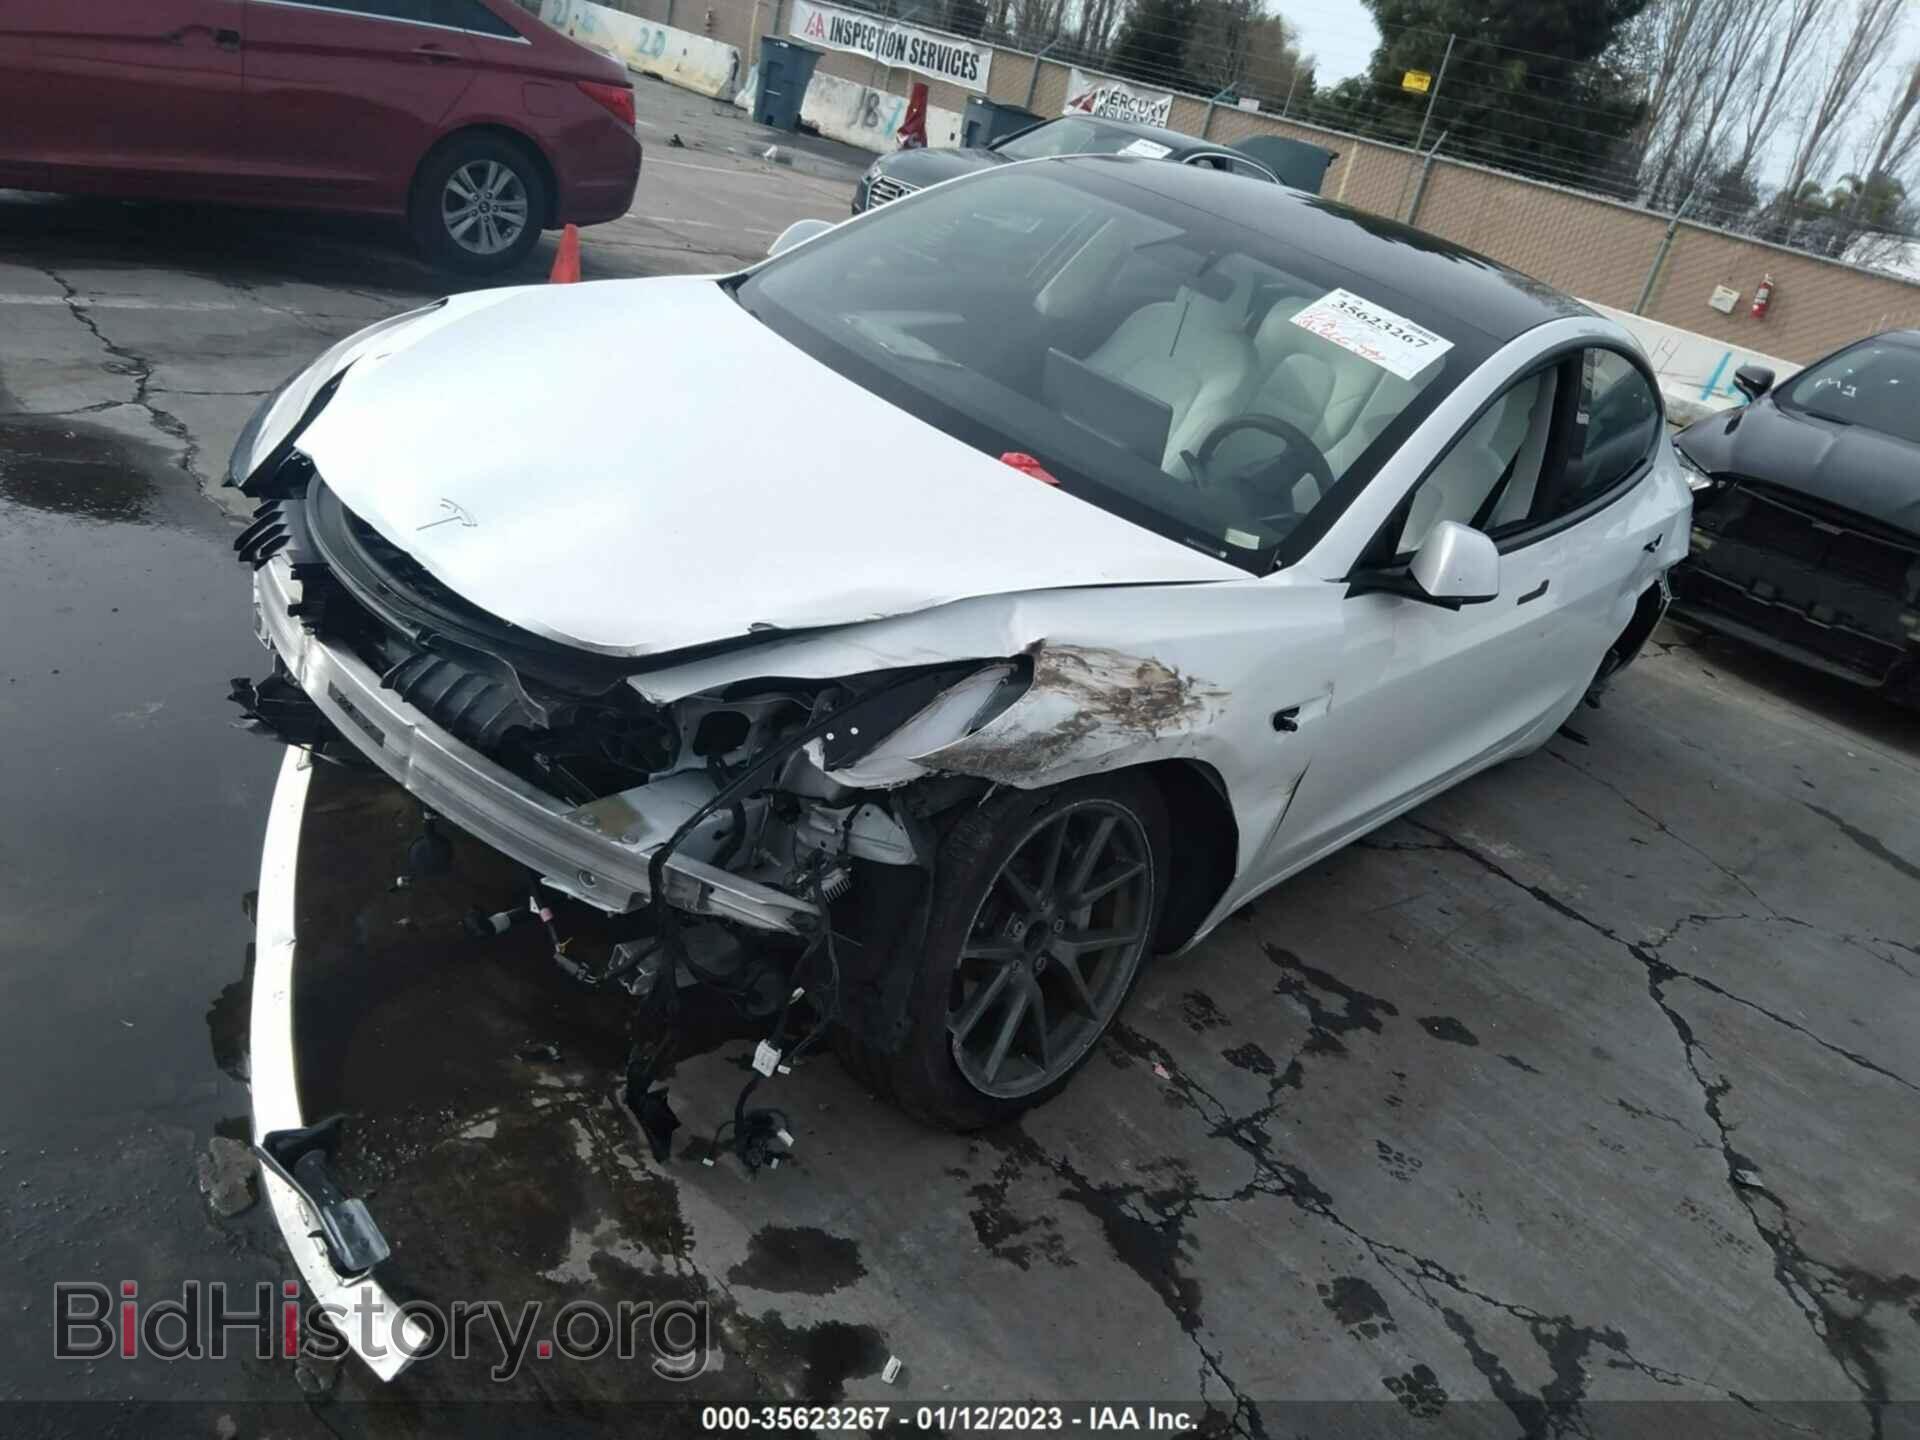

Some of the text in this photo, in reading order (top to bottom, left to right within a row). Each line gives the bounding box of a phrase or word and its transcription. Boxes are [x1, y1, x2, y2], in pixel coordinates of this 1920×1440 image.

[829, 16, 908, 61] INSPECTION
[909, 37, 980, 81] SERVICES
[1099, 89, 1168, 119] MERCURY
[1331, 300, 1429, 348] 35623267
